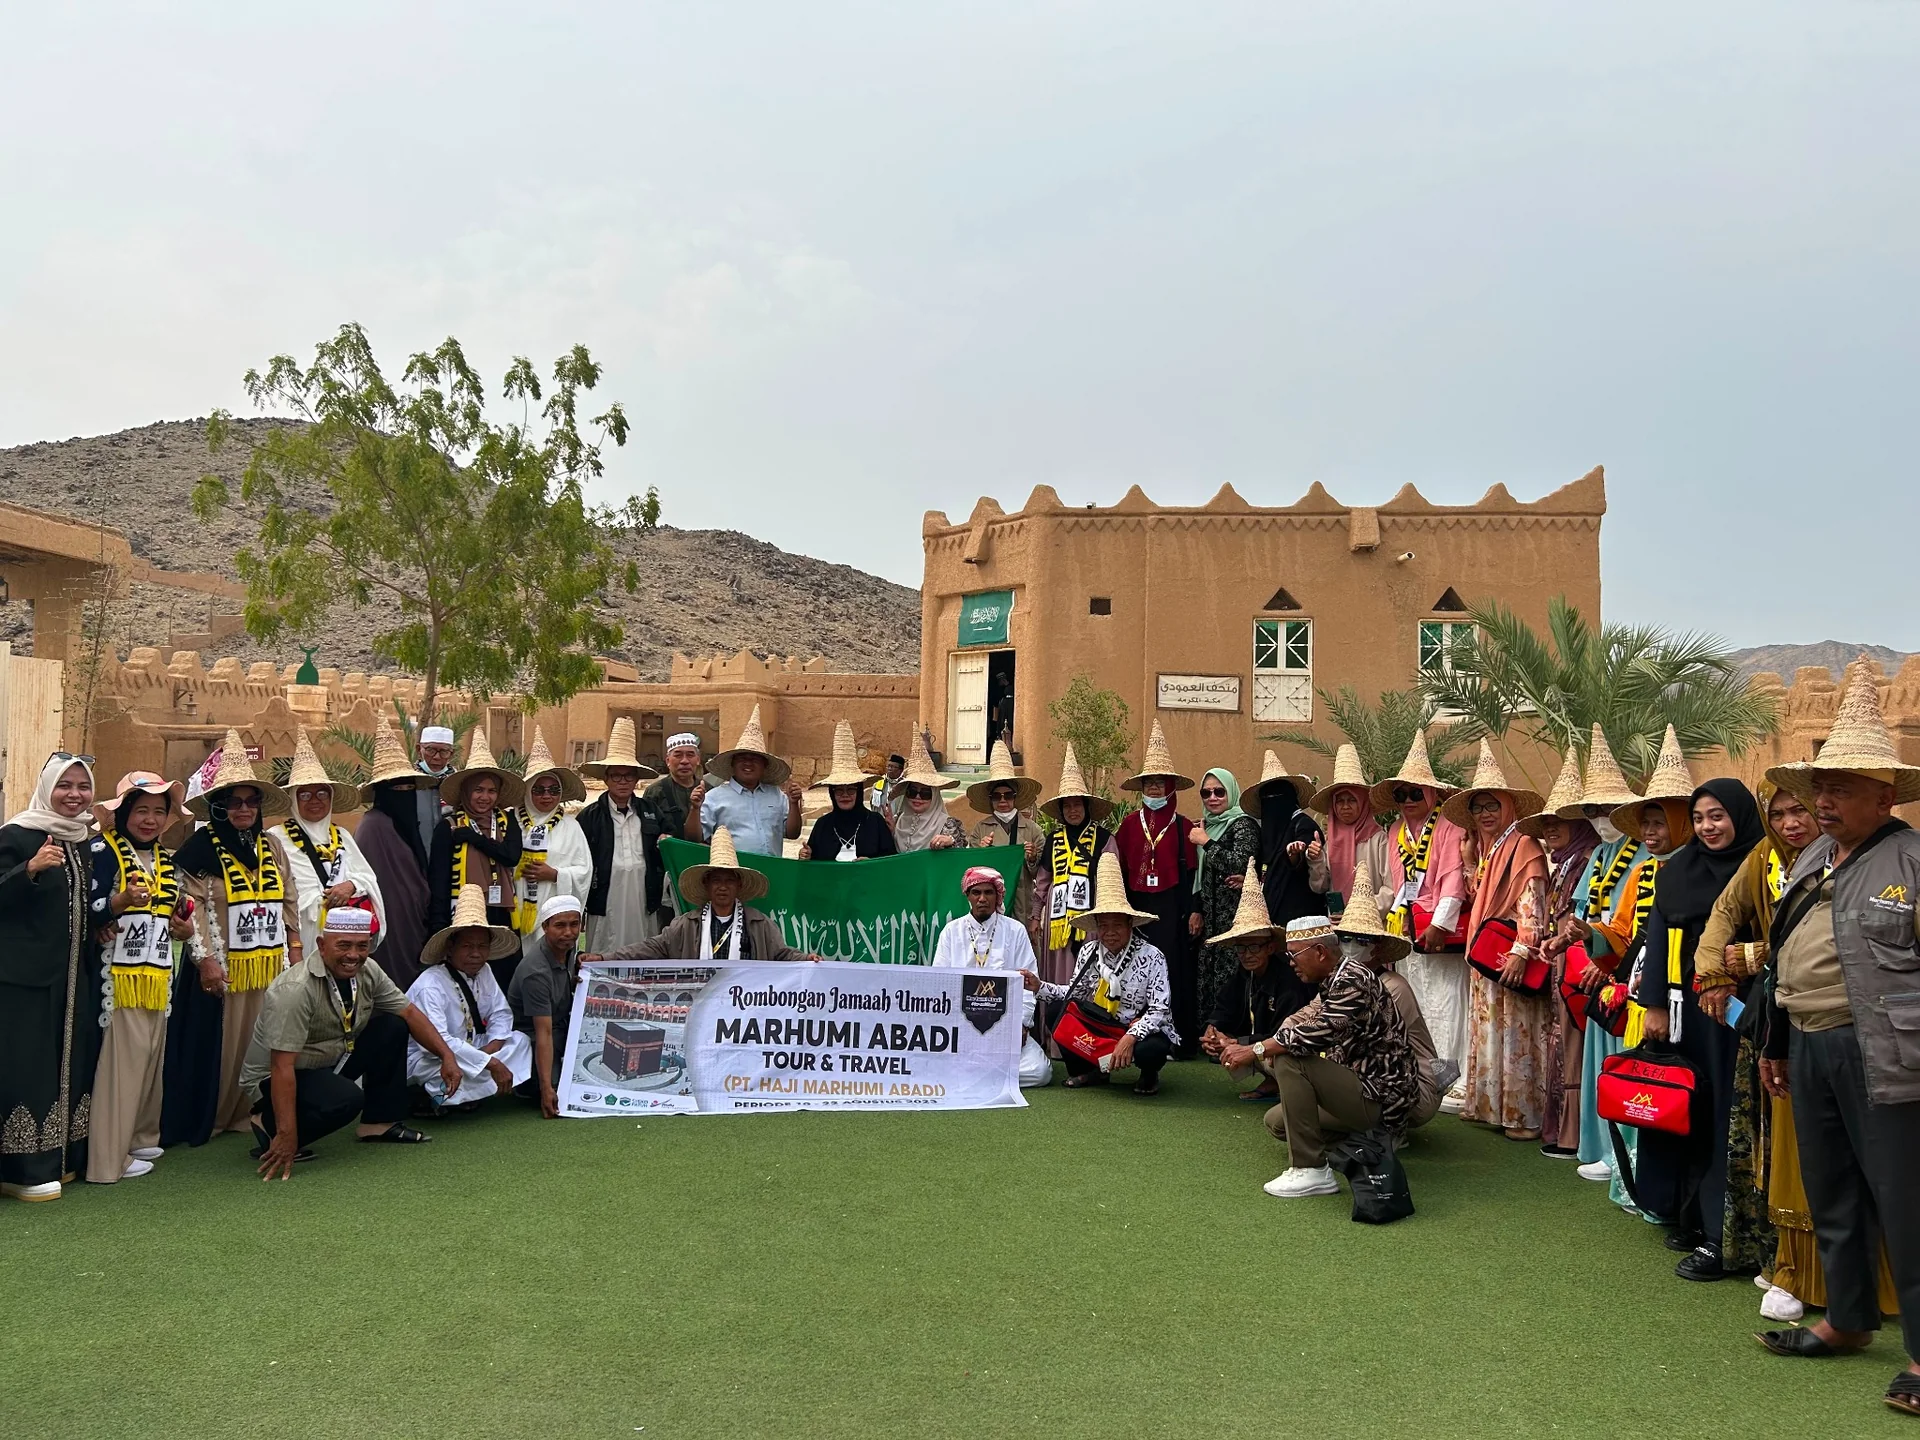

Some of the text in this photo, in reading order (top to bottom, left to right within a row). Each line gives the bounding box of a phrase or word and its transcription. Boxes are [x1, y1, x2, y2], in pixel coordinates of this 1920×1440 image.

[1160, 681, 1238, 695] متحف العمودي
[728, 984, 951, 1016] Rombongan Jamaah Umrah
[714, 1018, 959, 1054] MARHUMI ABADI
[761, 1051, 911, 1075] TOUR & TRAVEL
[1630, 1060, 1666, 1080] REFA
[724, 1074, 946, 1097] (PT. HAJI MARHUMI ABADI)
